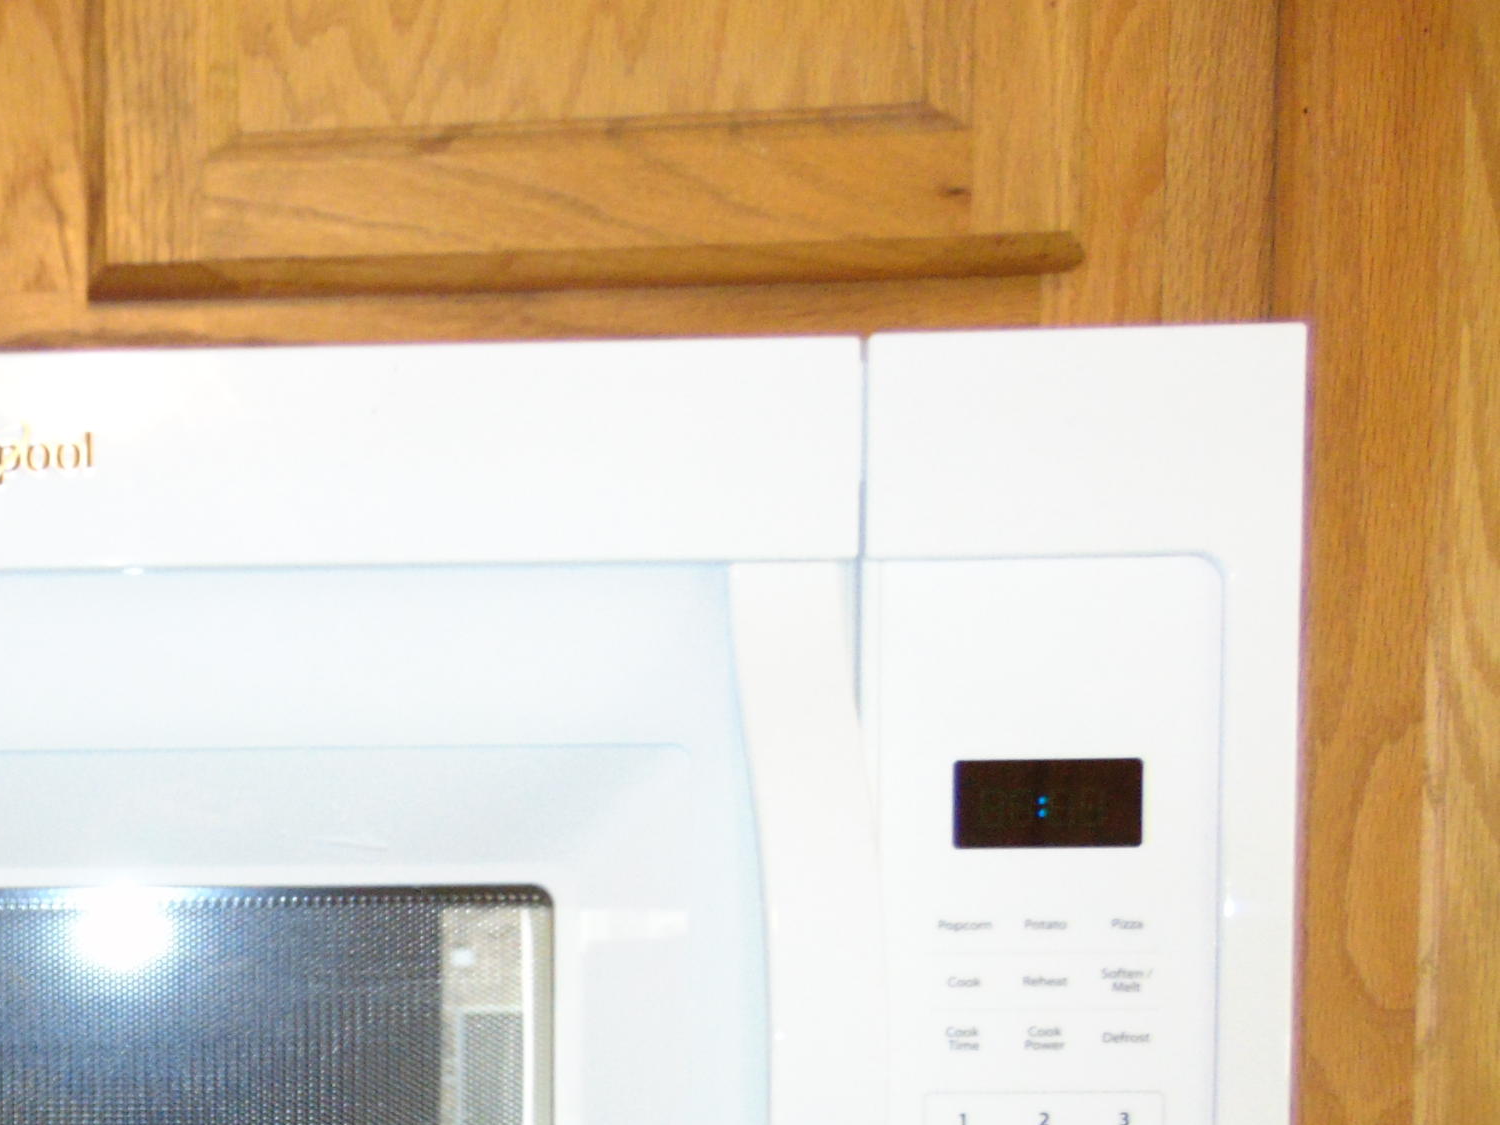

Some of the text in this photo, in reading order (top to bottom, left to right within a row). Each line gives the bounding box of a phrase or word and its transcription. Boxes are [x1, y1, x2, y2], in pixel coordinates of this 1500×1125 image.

[937, 919, 993, 933] Popcorn
[1024, 918, 1068, 931] Potato
[1110, 917, 1145, 931] Pizza
[1101, 967, 1145, 980] Soften
[946, 976, 982, 988] Cook
[1022, 975, 1069, 988] Reheat
[1110, 980, 1142, 993] Melt
[945, 1026, 980, 1038] Cook
[1027, 1026, 1062, 1038] Cook
[1101, 1031, 1151, 1044] Defrost
[948, 1039, 980, 1052] Time
[1023, 1039, 1066, 1051] Power
